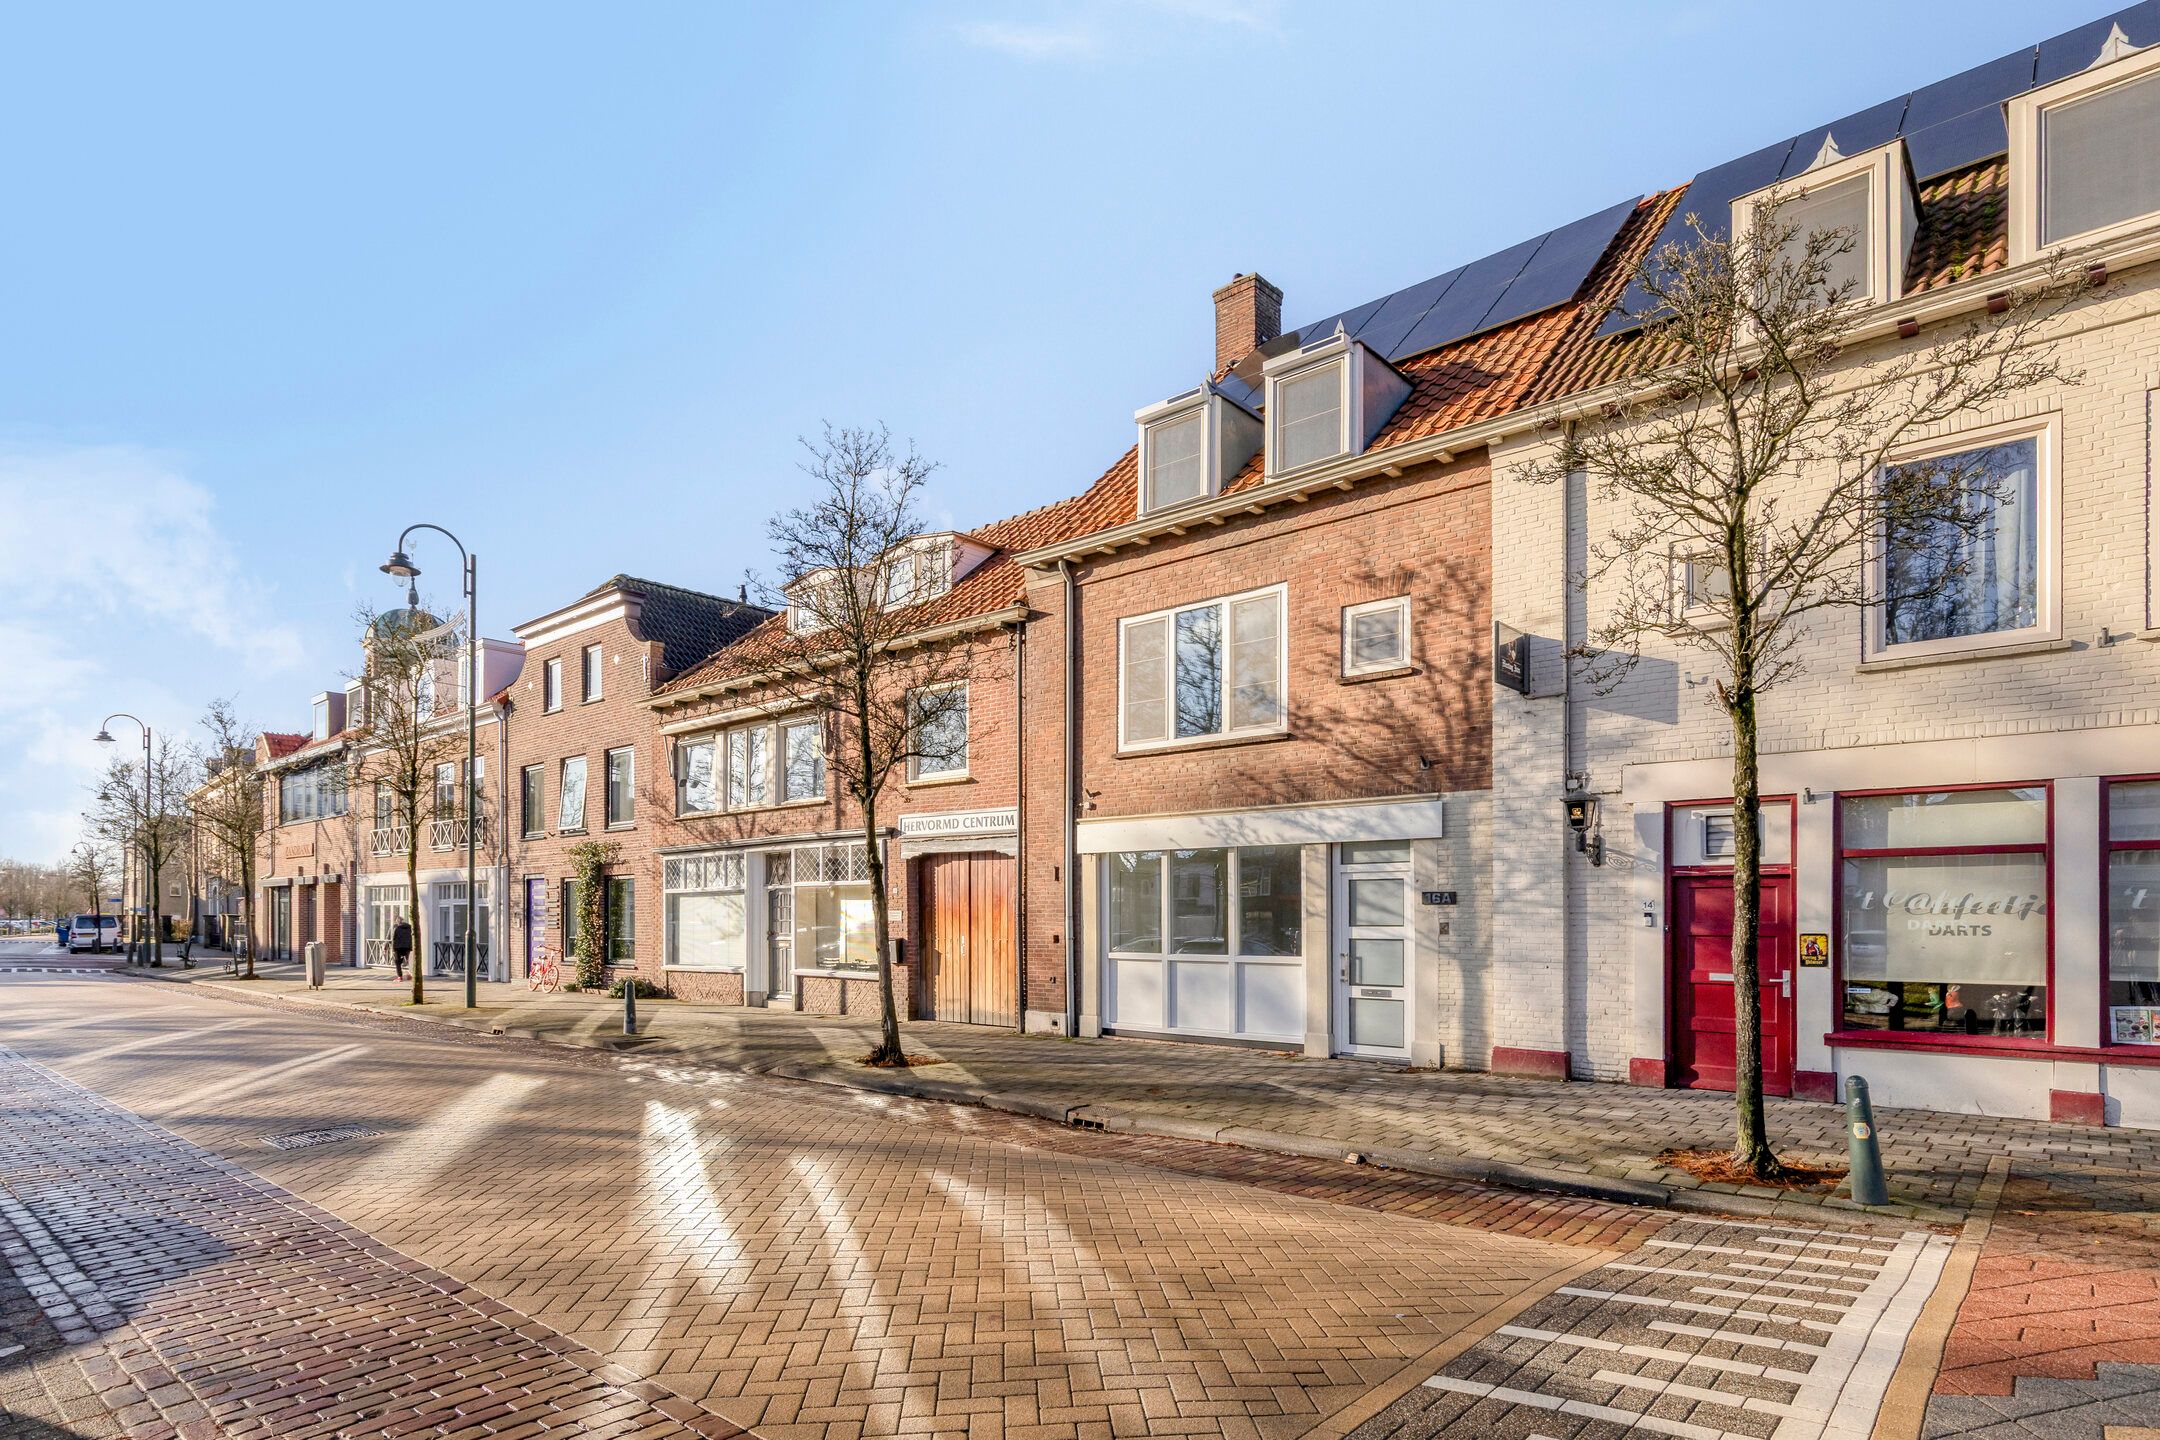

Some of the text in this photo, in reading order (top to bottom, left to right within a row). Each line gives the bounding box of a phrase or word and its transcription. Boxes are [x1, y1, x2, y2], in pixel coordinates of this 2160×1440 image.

[903, 814, 1015, 832] HERVORMD CENTRUM
[1425, 893, 1452, 904] 16A
[1927, 924, 1992, 936] DARTS
